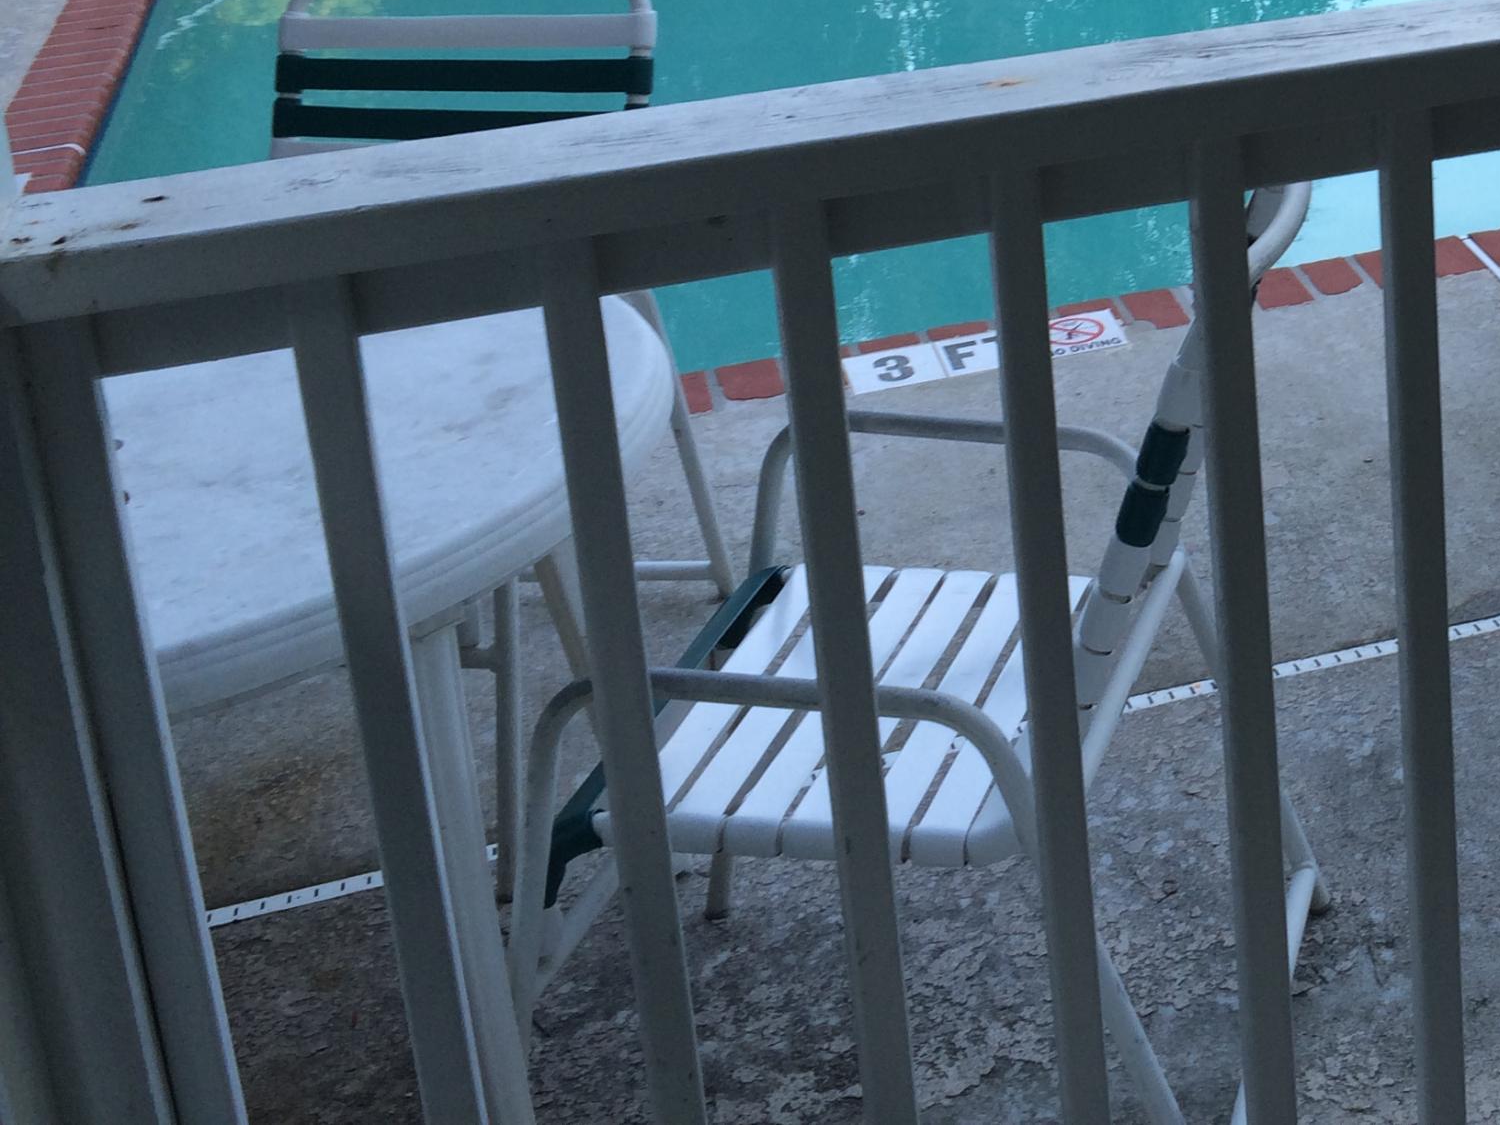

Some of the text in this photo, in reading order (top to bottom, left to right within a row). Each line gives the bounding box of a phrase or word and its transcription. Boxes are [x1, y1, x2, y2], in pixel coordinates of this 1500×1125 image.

[872, 336, 997, 382] 3 F
[1070, 337, 1122, 353] DIVING
